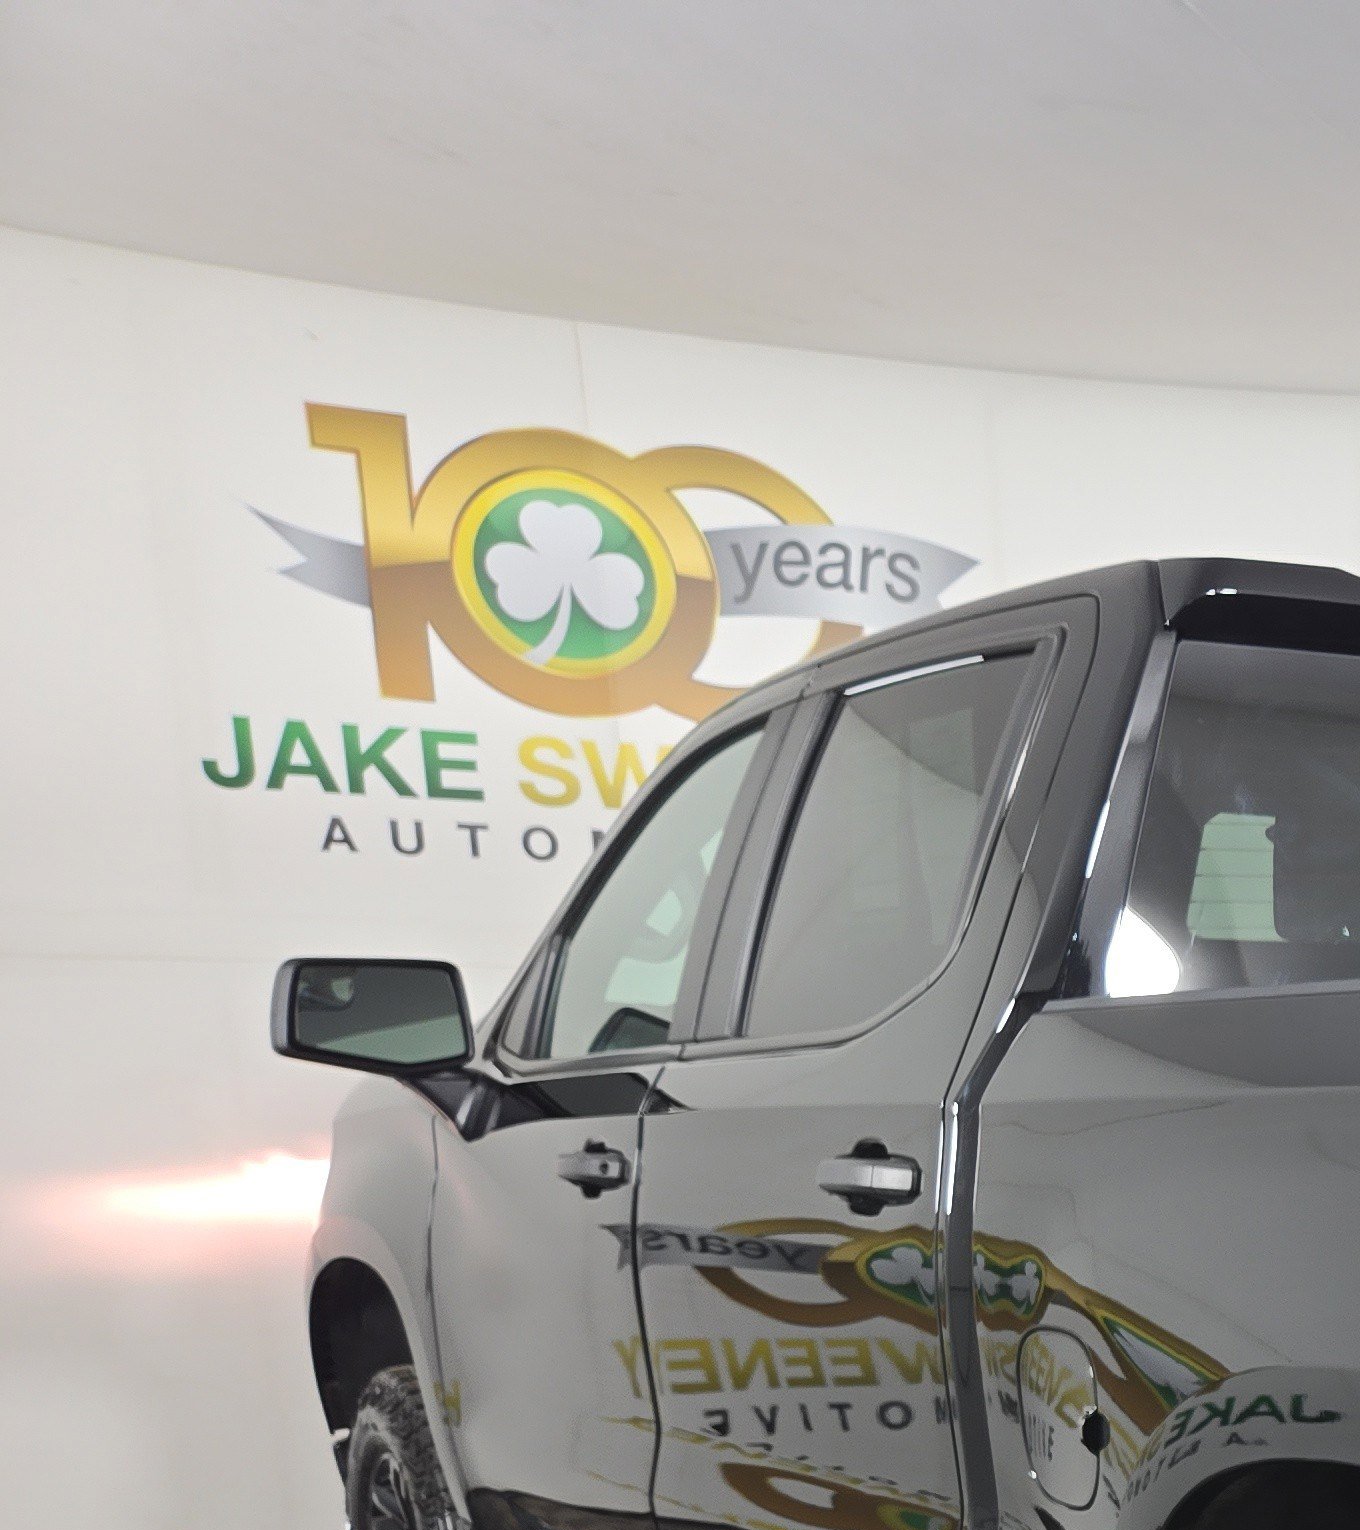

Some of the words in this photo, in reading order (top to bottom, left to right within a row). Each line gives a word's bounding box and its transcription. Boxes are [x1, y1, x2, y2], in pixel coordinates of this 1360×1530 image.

[730, 535, 922, 604] years
[201, 713, 486, 802] JAKE
[516, 733, 676, 809] SW
[321, 815, 604, 864] AUTO
